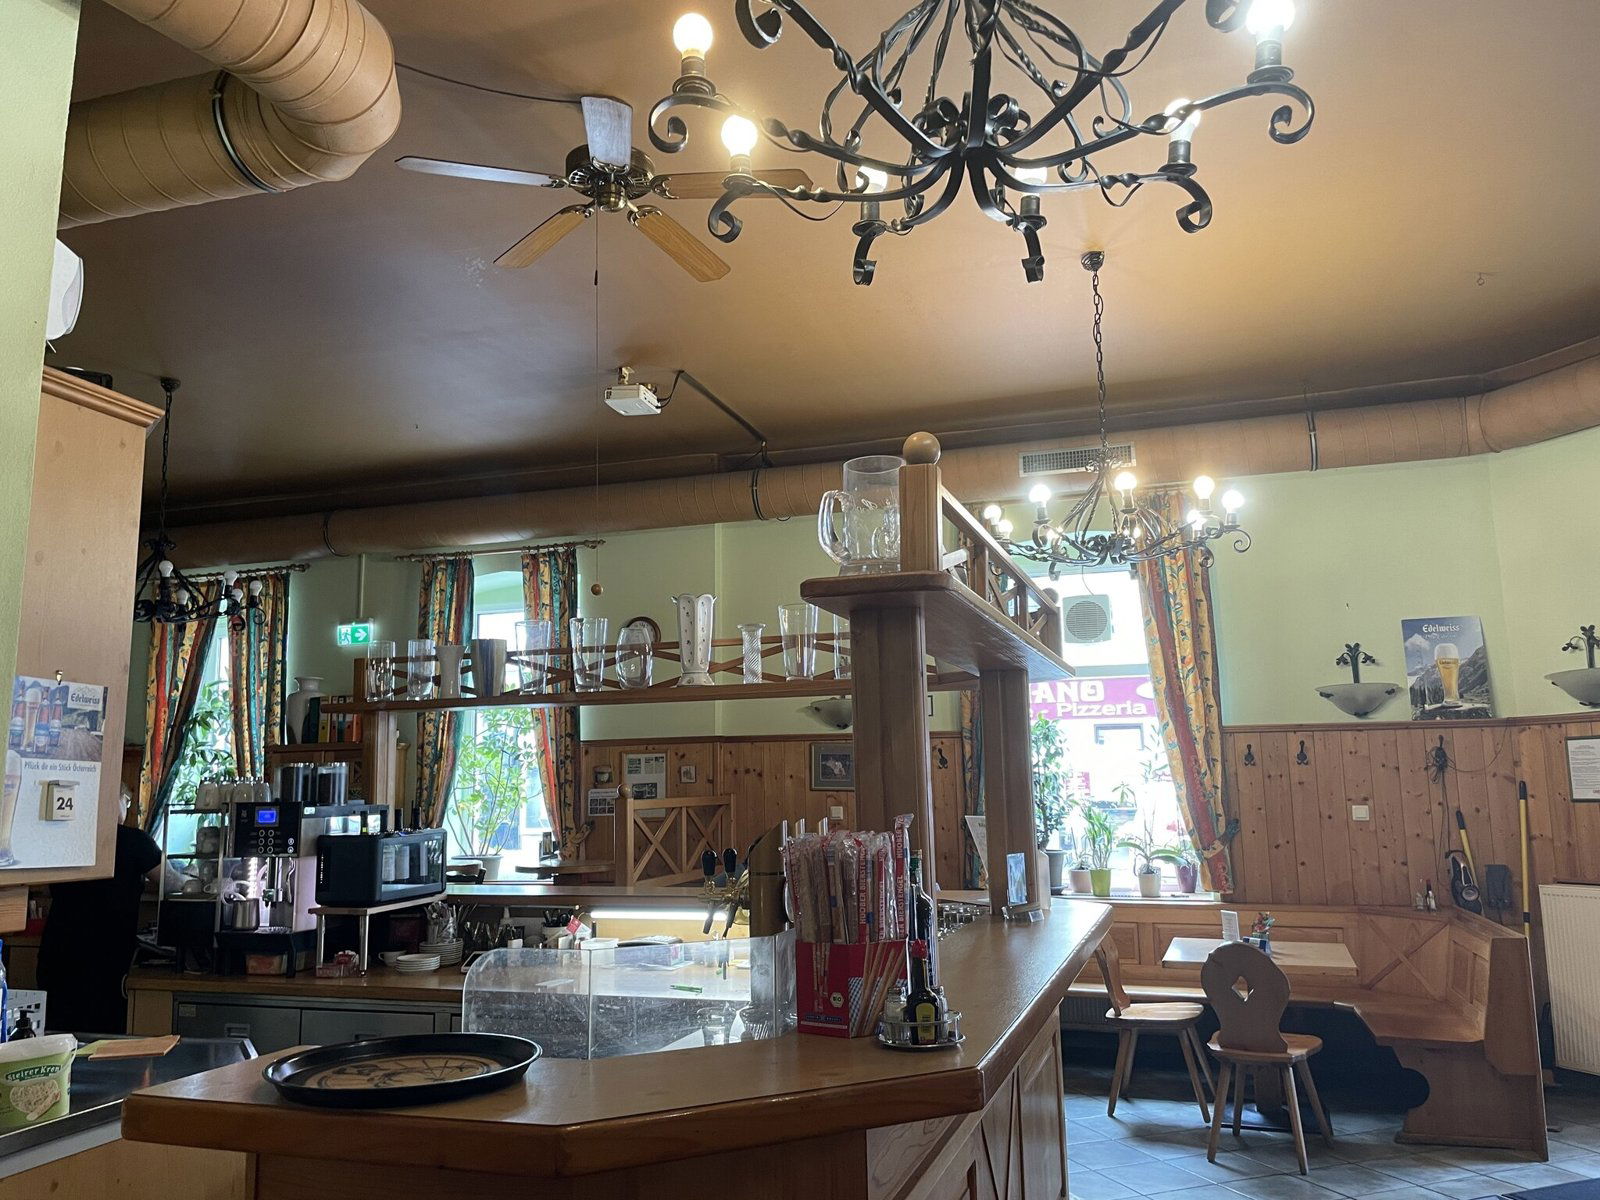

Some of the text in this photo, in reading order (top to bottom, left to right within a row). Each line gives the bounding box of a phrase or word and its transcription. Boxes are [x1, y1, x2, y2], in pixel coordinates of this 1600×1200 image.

[1422, 623, 1460, 633] Edelweiss
[70, 692, 100, 705] Edelweiss
[1056, 700, 1148, 718] Pizzeria
[56, 796, 74, 811] 24
[7, 1067, 40, 1081] Steirer
